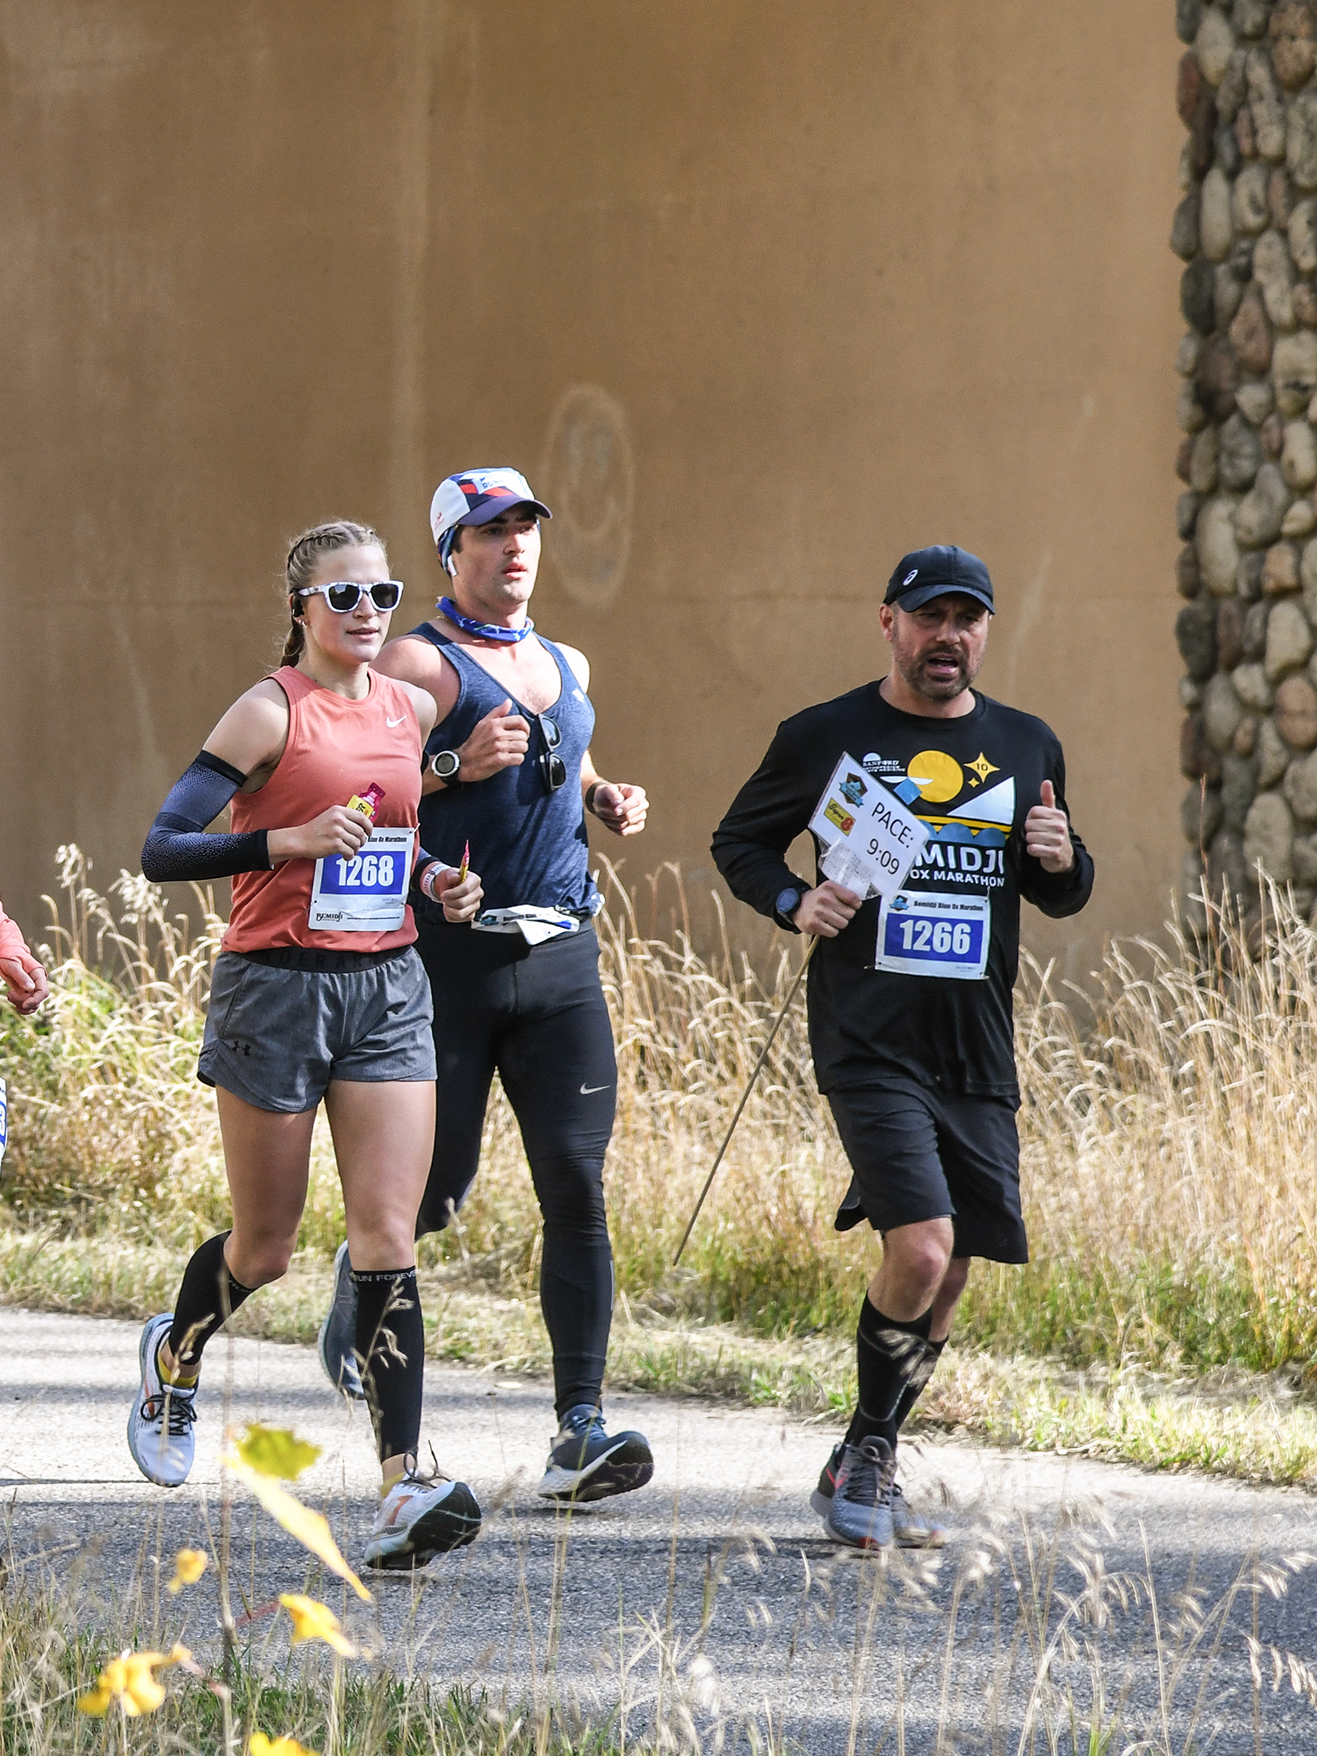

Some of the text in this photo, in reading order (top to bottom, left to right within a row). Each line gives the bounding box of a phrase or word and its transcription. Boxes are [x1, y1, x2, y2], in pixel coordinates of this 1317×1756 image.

[976, 762, 989, 772] 10
[871, 801, 914, 849] PACE:
[336, 855, 394, 887] 1268
[866, 838, 900, 875] 9:09
[915, 843, 1004, 875] MIDJI
[910, 868, 1004, 887] OX MARATHON
[913, 900, 937, 909] Bemidji
[938, 902, 951, 910] Blue
[959, 903, 984, 912] Marathon
[899, 919, 971, 955] 1266
[376, 1270, 415, 1282] FOREVE
